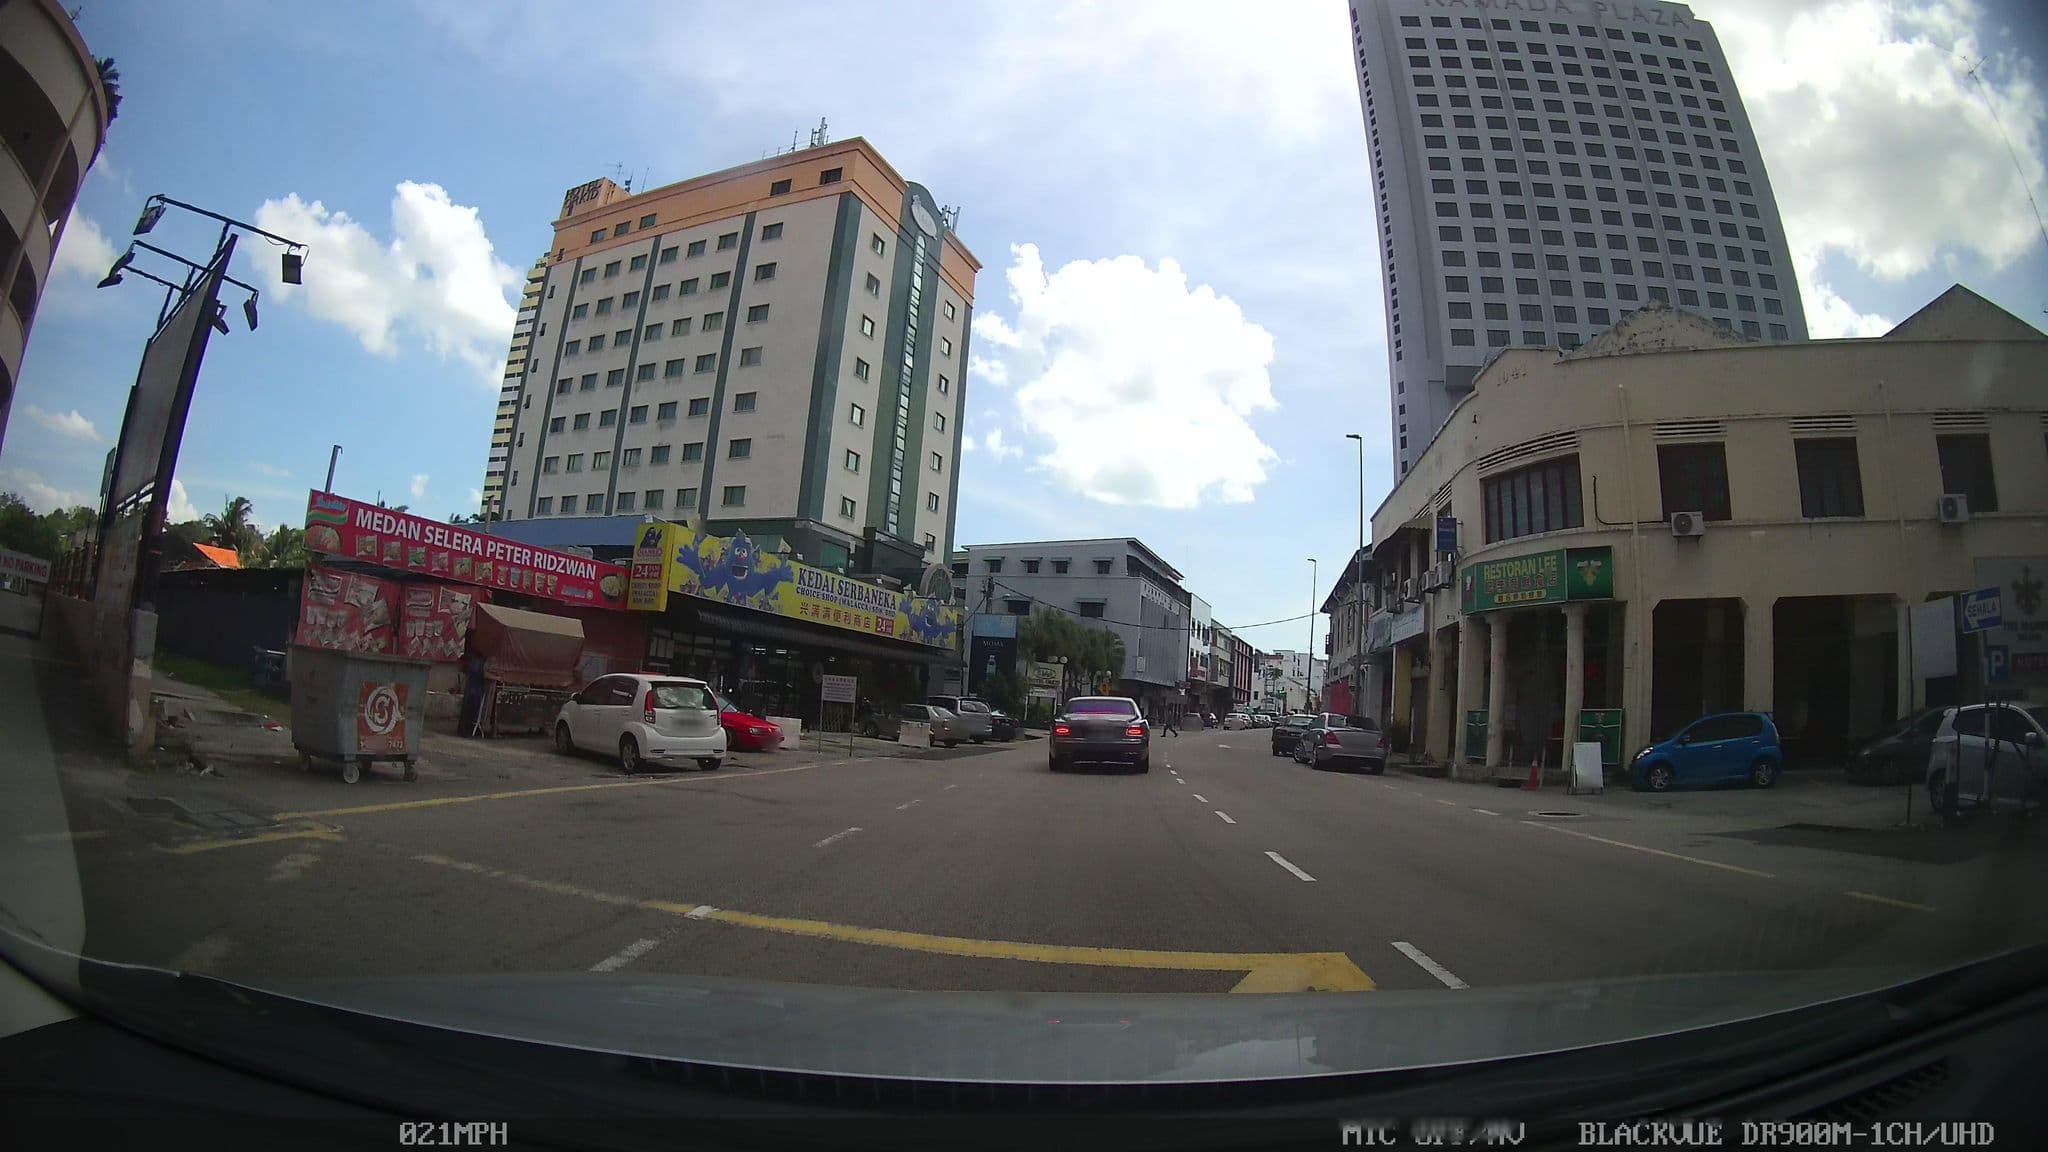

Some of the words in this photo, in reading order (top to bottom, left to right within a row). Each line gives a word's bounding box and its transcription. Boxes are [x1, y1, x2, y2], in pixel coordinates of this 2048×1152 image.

[1593, 1, 1690, 29] PLAZA
[355, 508, 421, 541] MEDAN
[424, 525, 483, 556] SELERA
[486, 540, 531, 567] PETER
[533, 551, 597, 581] RIDZWAN
[635, 565, 649, 578] 24
[1483, 558, 1537, 580] RESTORAN
[1538, 555, 1558, 574] LEE
[796, 586, 822, 599] CHOICE
[797, 567, 835, 594] KEDAI
[837, 579, 897, 611] SERBANEKA
[1967, 600, 1998, 618] SEHALA
[876, 618, 887, 632] 24
